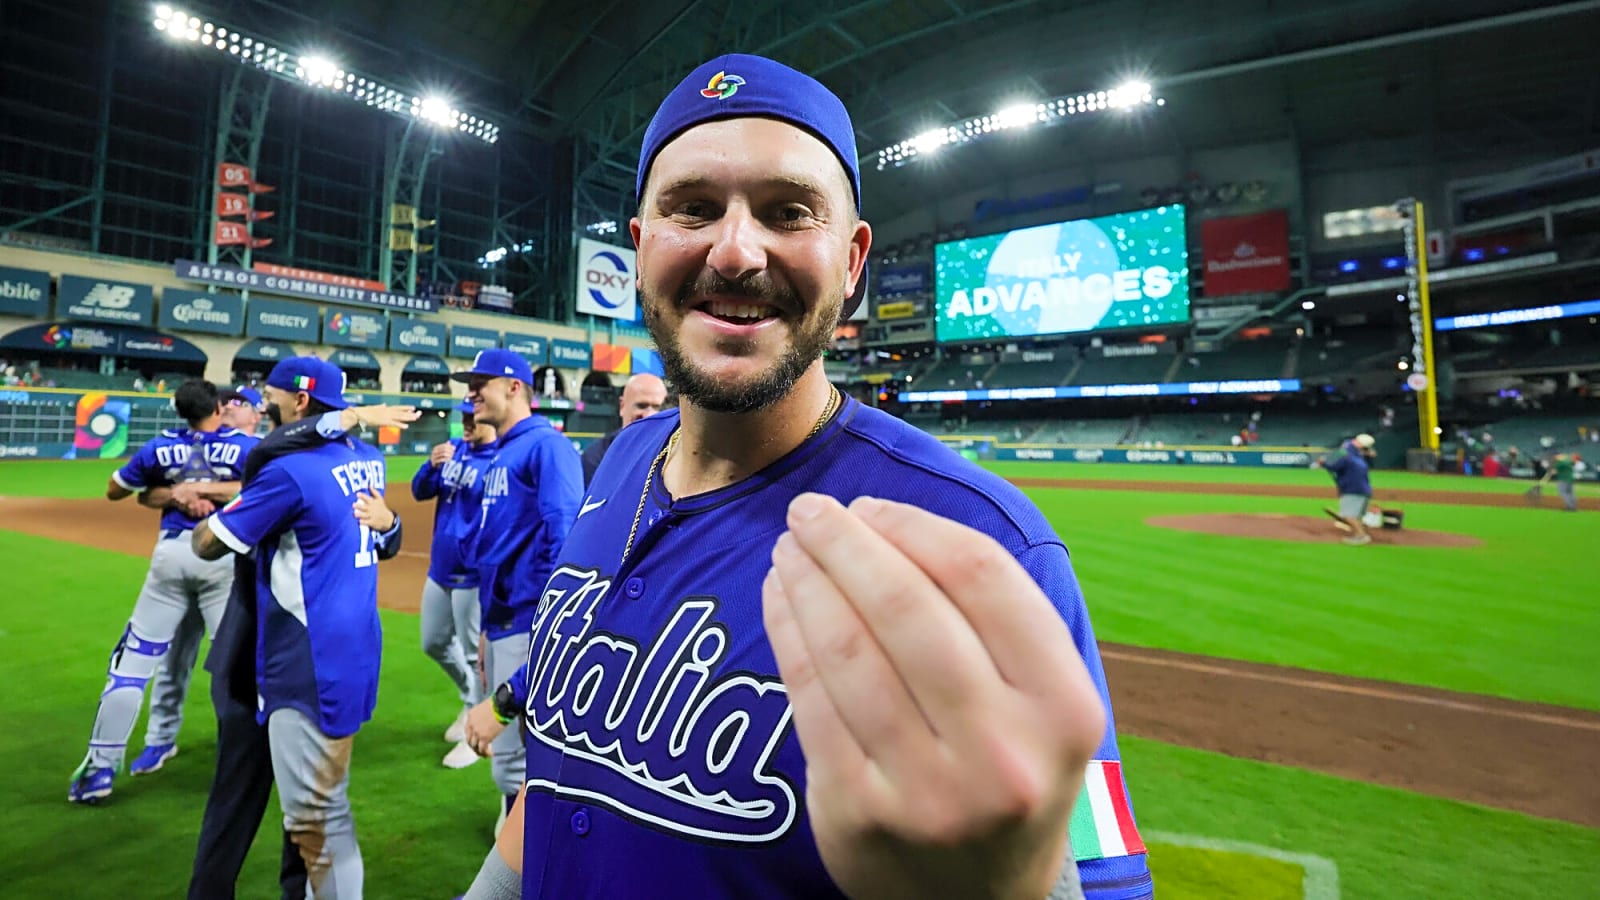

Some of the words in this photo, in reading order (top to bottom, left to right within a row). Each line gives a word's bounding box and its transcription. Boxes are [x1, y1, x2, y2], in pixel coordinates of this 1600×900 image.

[1018, 251, 1082, 278] ITALY
[188, 265, 259, 285] ASTROS
[265, 276, 366, 301] COMMUNITY
[371, 292, 431, 310] LEADERS
[586, 269, 630, 290] OXY
[0, 281, 42, 301] bile
[947, 266, 1172, 318] ADVANCES
[68, 305, 94, 316] new
[94, 307, 141, 321] balance
[173, 303, 231, 324] Corona
[259, 312, 309, 329] DIRECTV
[524, 564, 796, 815] Italia
